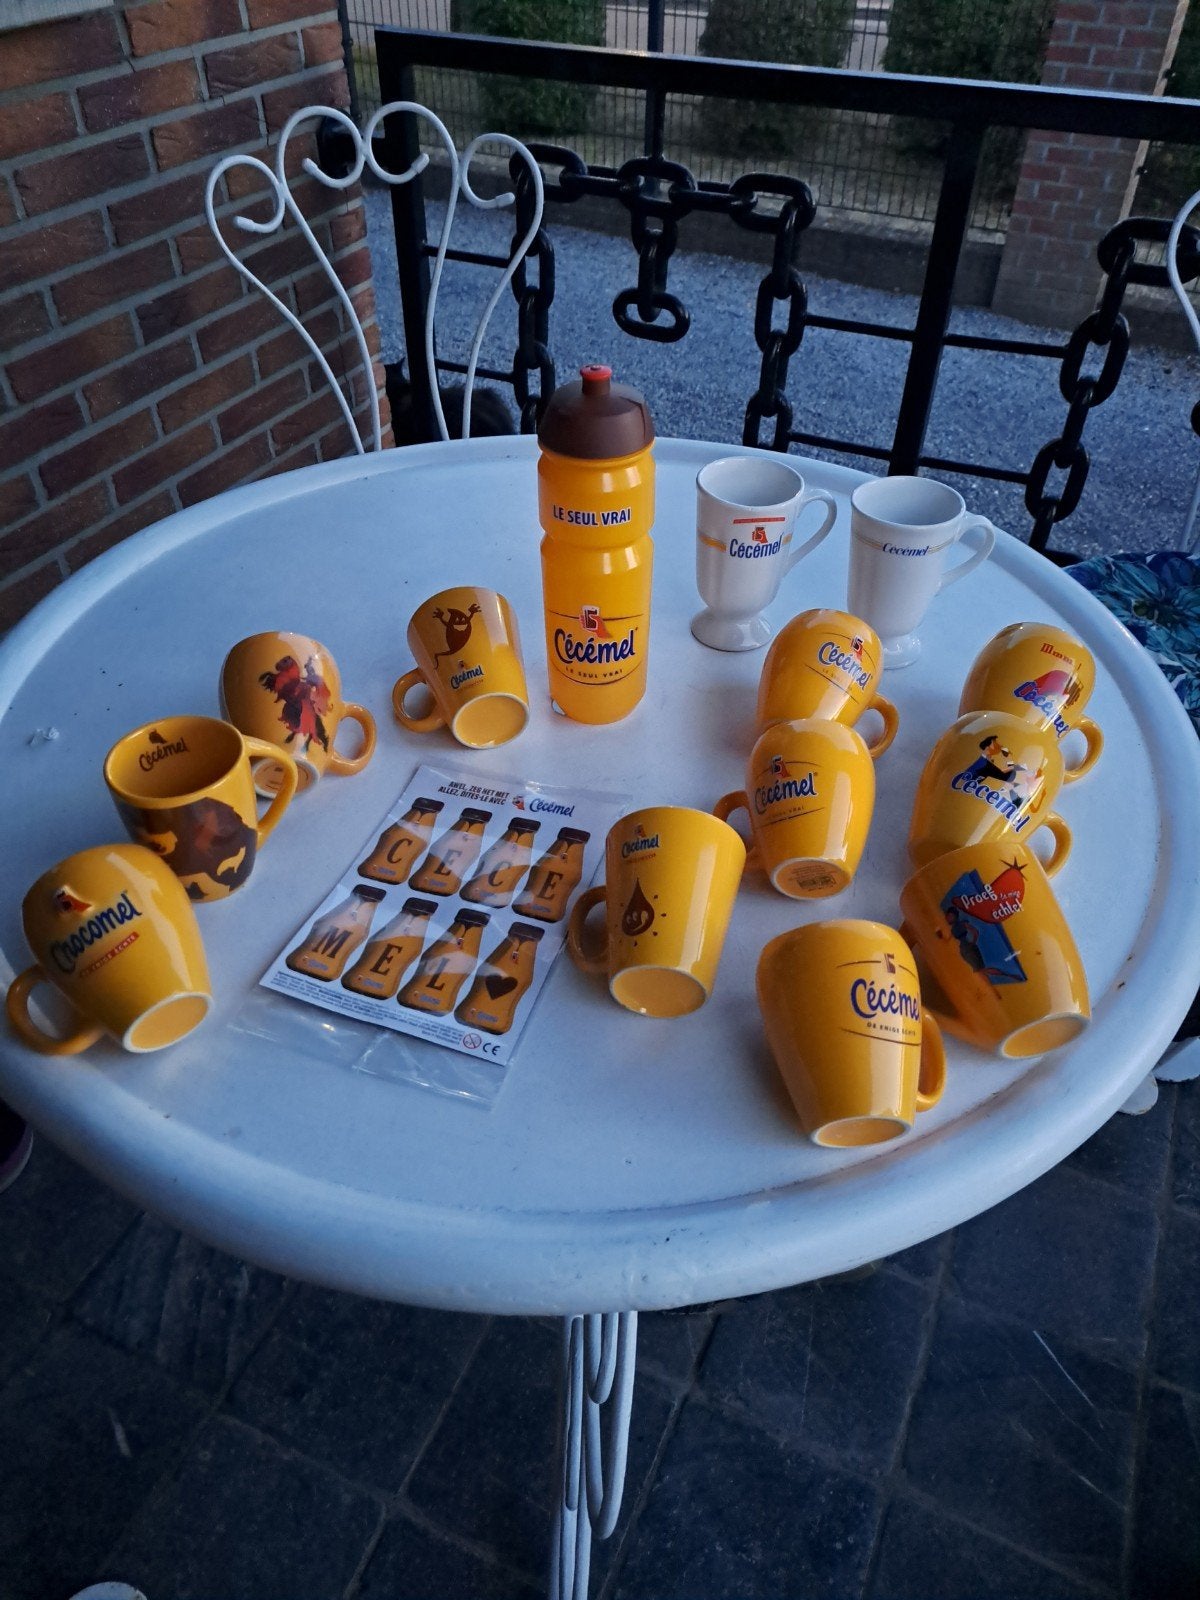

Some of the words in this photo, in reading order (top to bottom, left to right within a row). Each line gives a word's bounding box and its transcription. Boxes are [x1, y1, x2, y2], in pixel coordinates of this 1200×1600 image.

[553, 504, 565, 521] LE
[567, 510, 598, 525] SEUL
[601, 507, 632, 525] VRAI
[729, 532, 784, 559] Cécémel
[555, 628, 636, 664] Cécémel
[386, 837, 413, 864] C
[434, 849, 464, 876] E
[487, 860, 513, 887] C
[537, 870, 564, 899] E
[312, 925, 353, 959] M
[370, 943, 403, 976] E
[426, 956, 450, 991] L
[851, 978, 920, 1022] Cécéme
